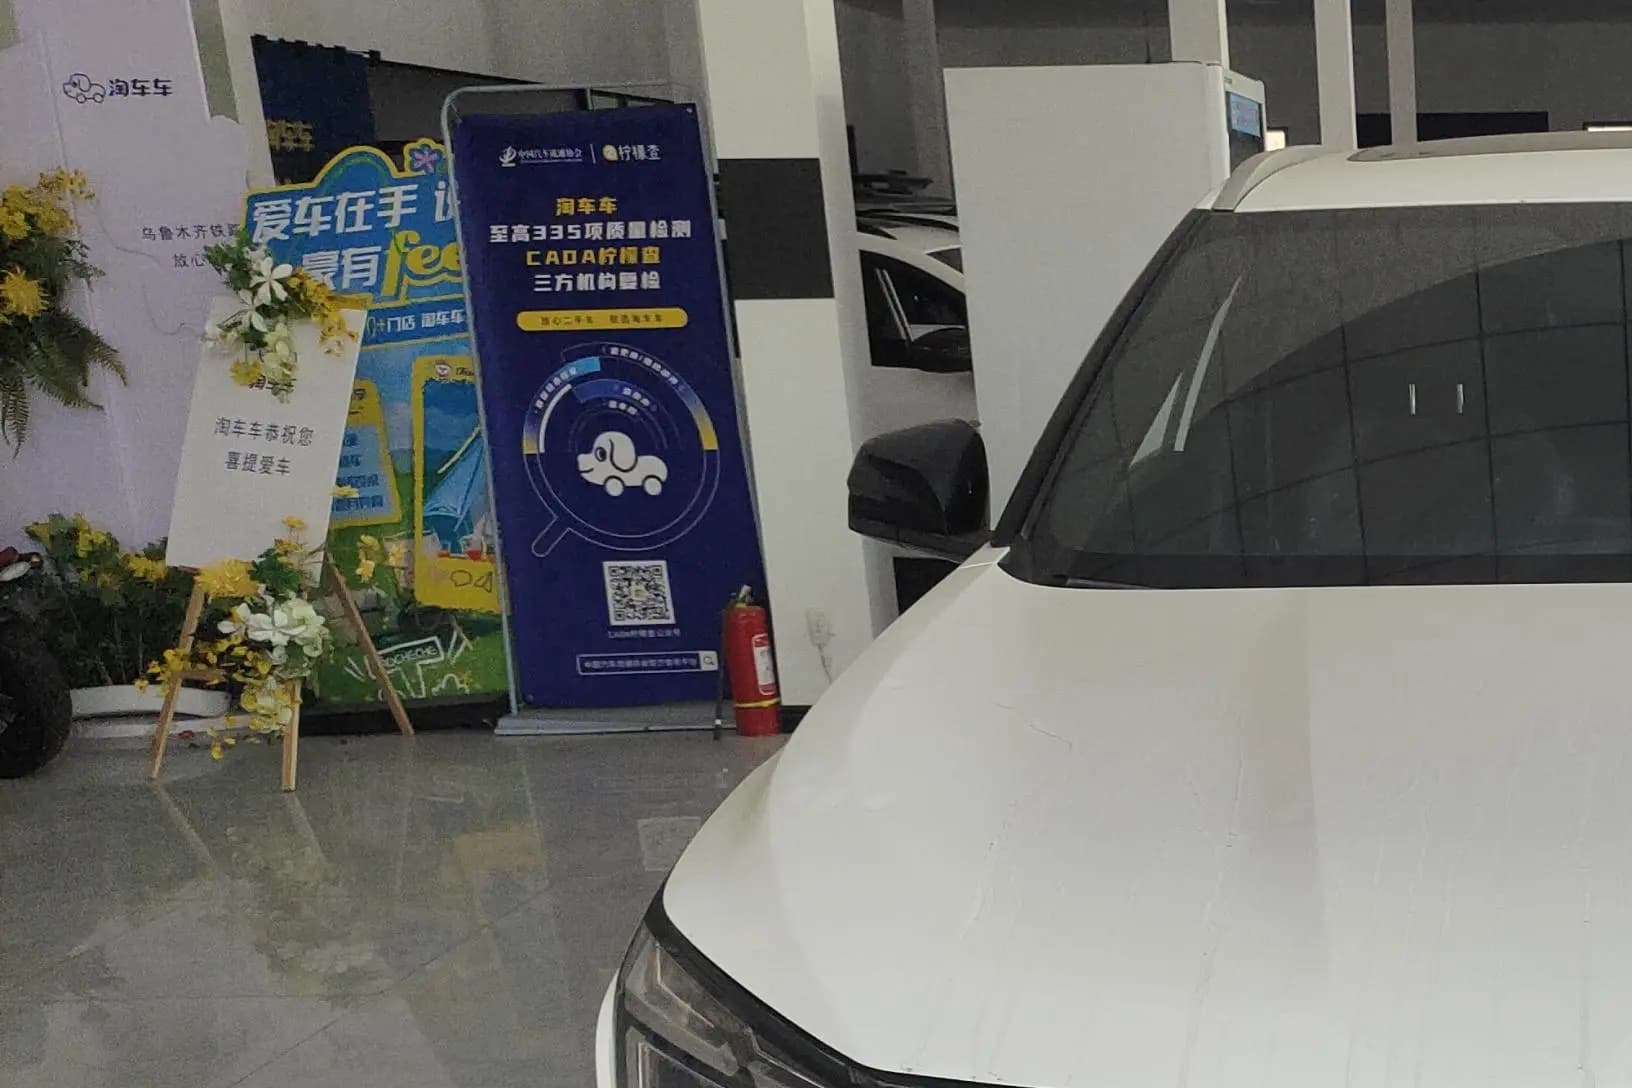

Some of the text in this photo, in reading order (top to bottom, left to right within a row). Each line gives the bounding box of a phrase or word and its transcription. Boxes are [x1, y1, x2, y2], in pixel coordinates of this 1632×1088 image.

[108, 78, 173, 97] 淘车车
[252, 184, 419, 243] 爱车在手
[555, 197, 618, 216] 淘车车
[489, 220, 692, 243] 至高335项质量检测
[526, 246, 661, 266] CADA柠檬查
[533, 271, 661, 292] 三方机构复检
[214, 416, 314, 446] 淘车车恭祝您
[225, 451, 291, 475] 喜提爱车
